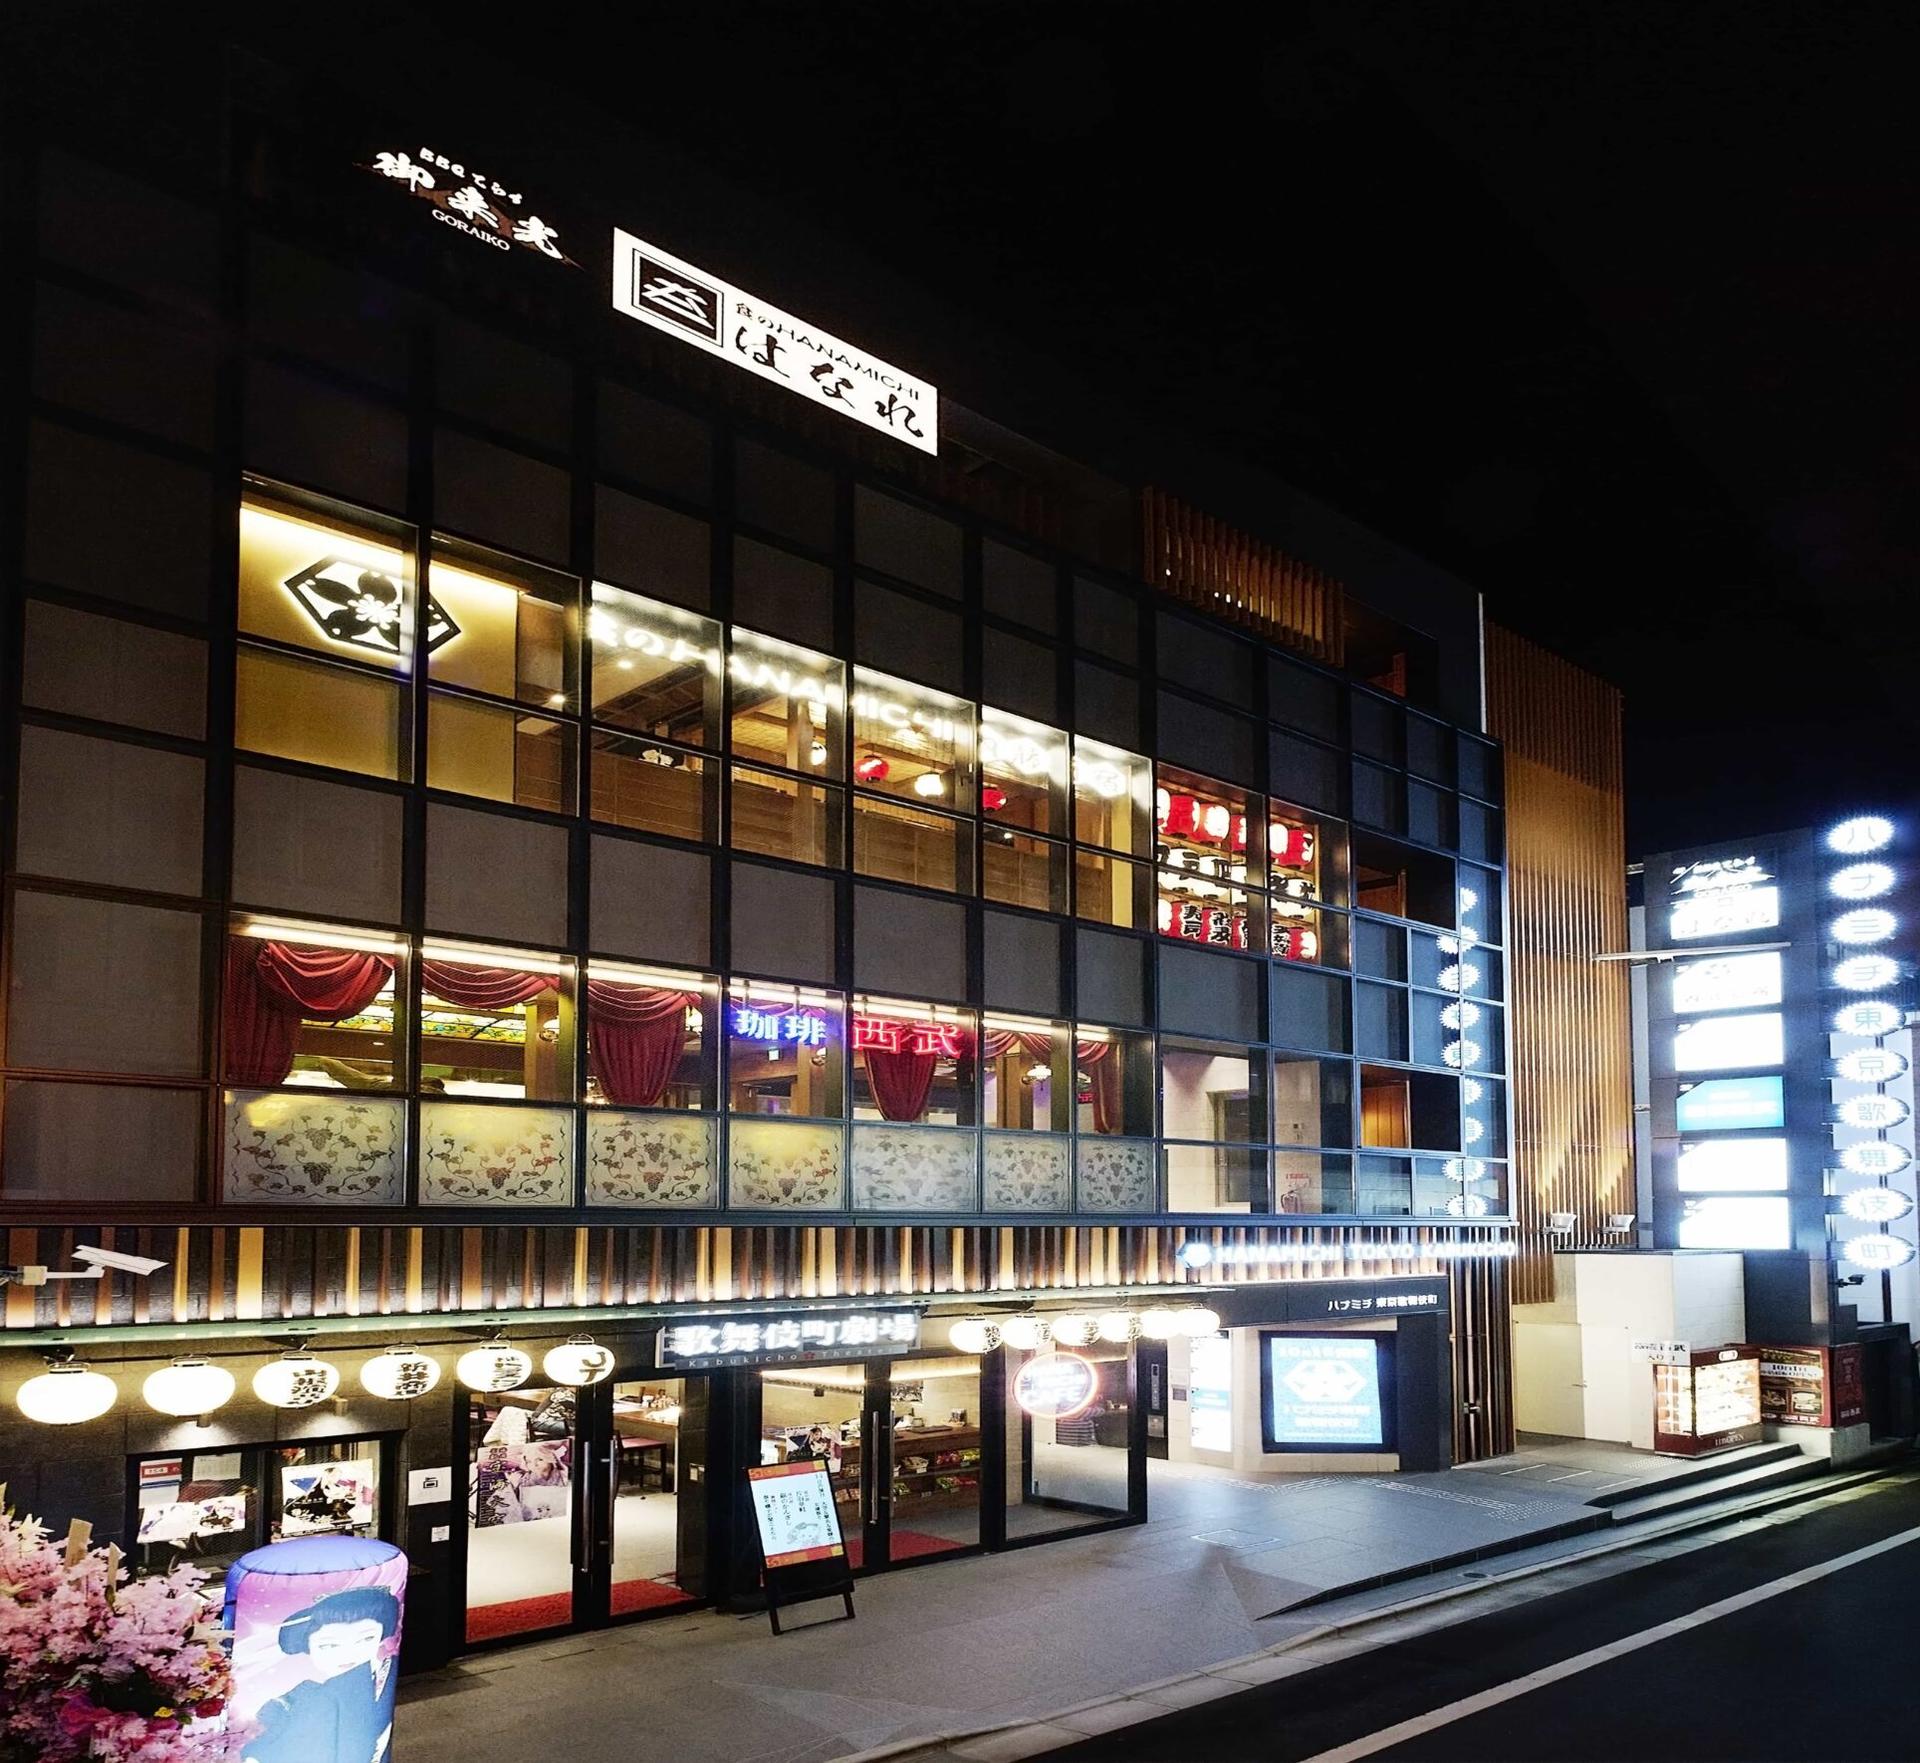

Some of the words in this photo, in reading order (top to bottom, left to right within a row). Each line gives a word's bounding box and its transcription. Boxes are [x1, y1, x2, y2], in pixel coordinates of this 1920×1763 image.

[419, 147, 465, 178] BBQ
[431, 208, 511, 251] GORAIKO
[735, 302, 920, 401] 食のHANAMICHI
[735, 326, 924, 438] はなれ
[736, 1009, 827, 1046] 珈琲
[852, 1016, 964, 1057] 西武
[1216, 1243, 1342, 1263] HANAMICHI
[1351, 1243, 1415, 1261] TOKYO
[1420, 1241, 1516, 1258] KABUKICHO
[1328, 1298, 1373, 1312] ハナミチ
[673, 1313, 917, 1358] 歌舞伎町劇場
[688, 1353, 798, 1369] Kabukicho
